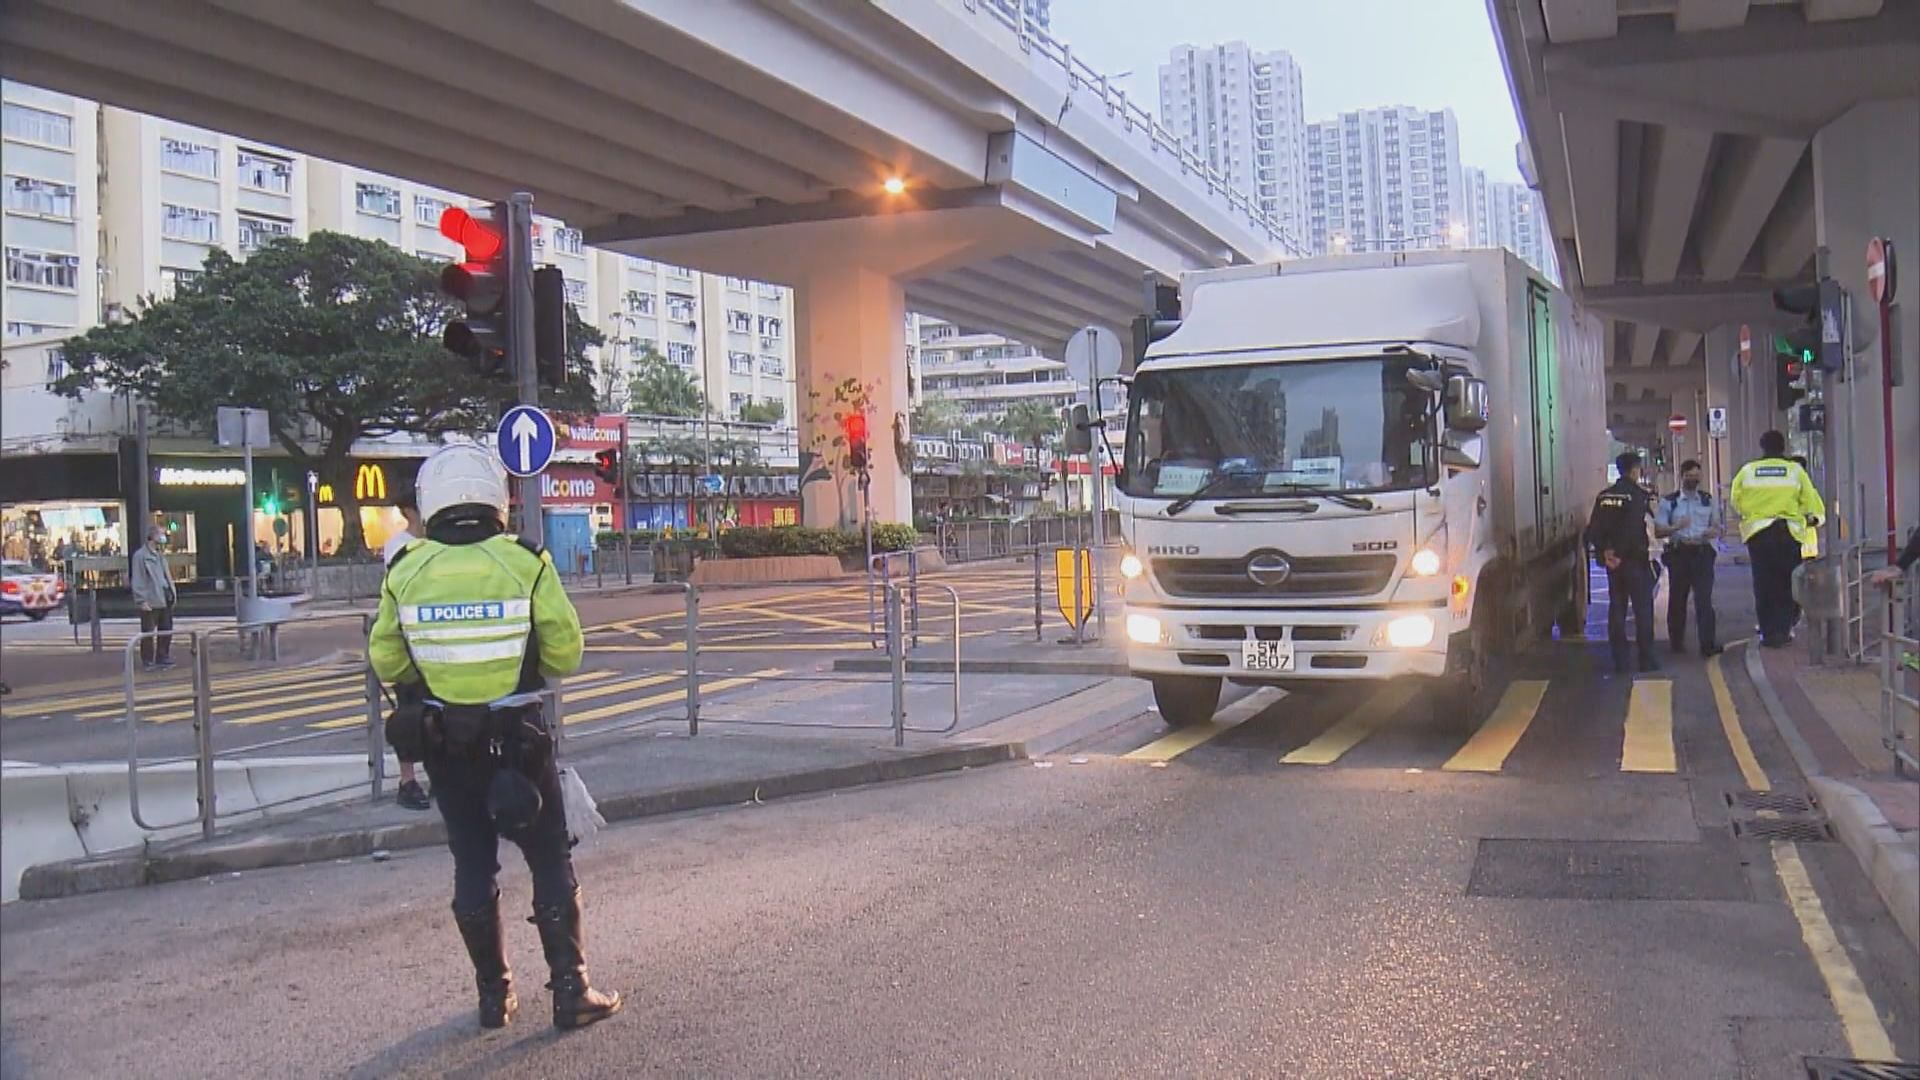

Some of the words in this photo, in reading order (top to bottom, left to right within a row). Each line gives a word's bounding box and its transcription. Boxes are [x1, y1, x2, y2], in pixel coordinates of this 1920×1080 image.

[541, 474, 595, 497] llcome
[1148, 545, 1200, 555] HINO
[434, 605, 484, 620] POLICE
[1257, 641, 1278, 656] SW
[1247, 653, 1290, 670] 2607
